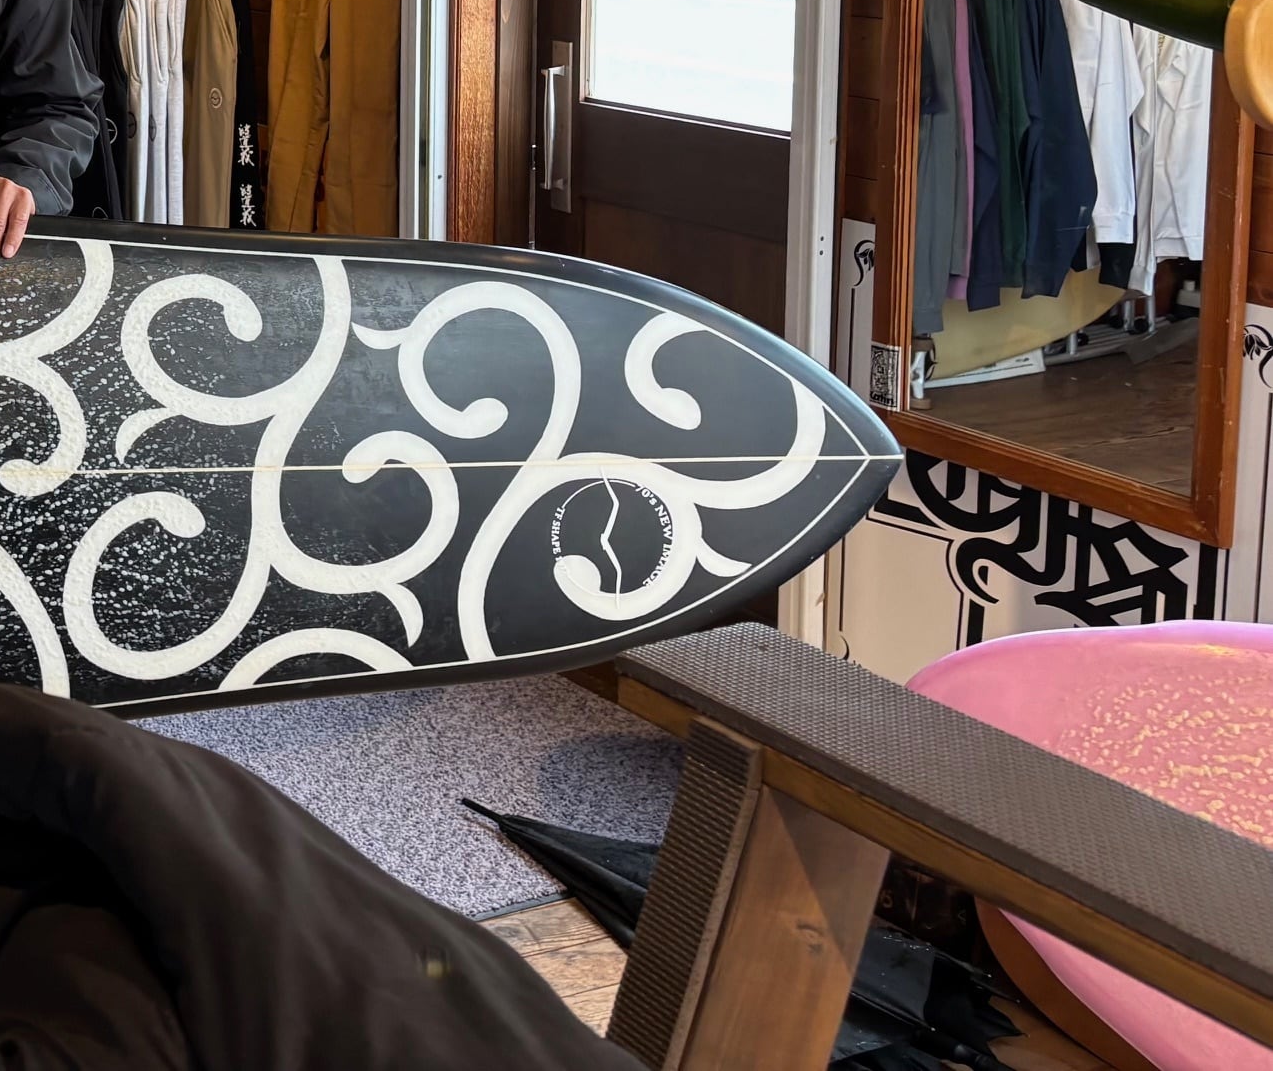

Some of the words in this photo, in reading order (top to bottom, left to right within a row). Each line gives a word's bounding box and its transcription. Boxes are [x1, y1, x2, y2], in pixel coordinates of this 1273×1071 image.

[555, 507, 565, 521] TF
[654, 505, 674, 538] NEW
[550, 520, 563, 556] SHAPE
